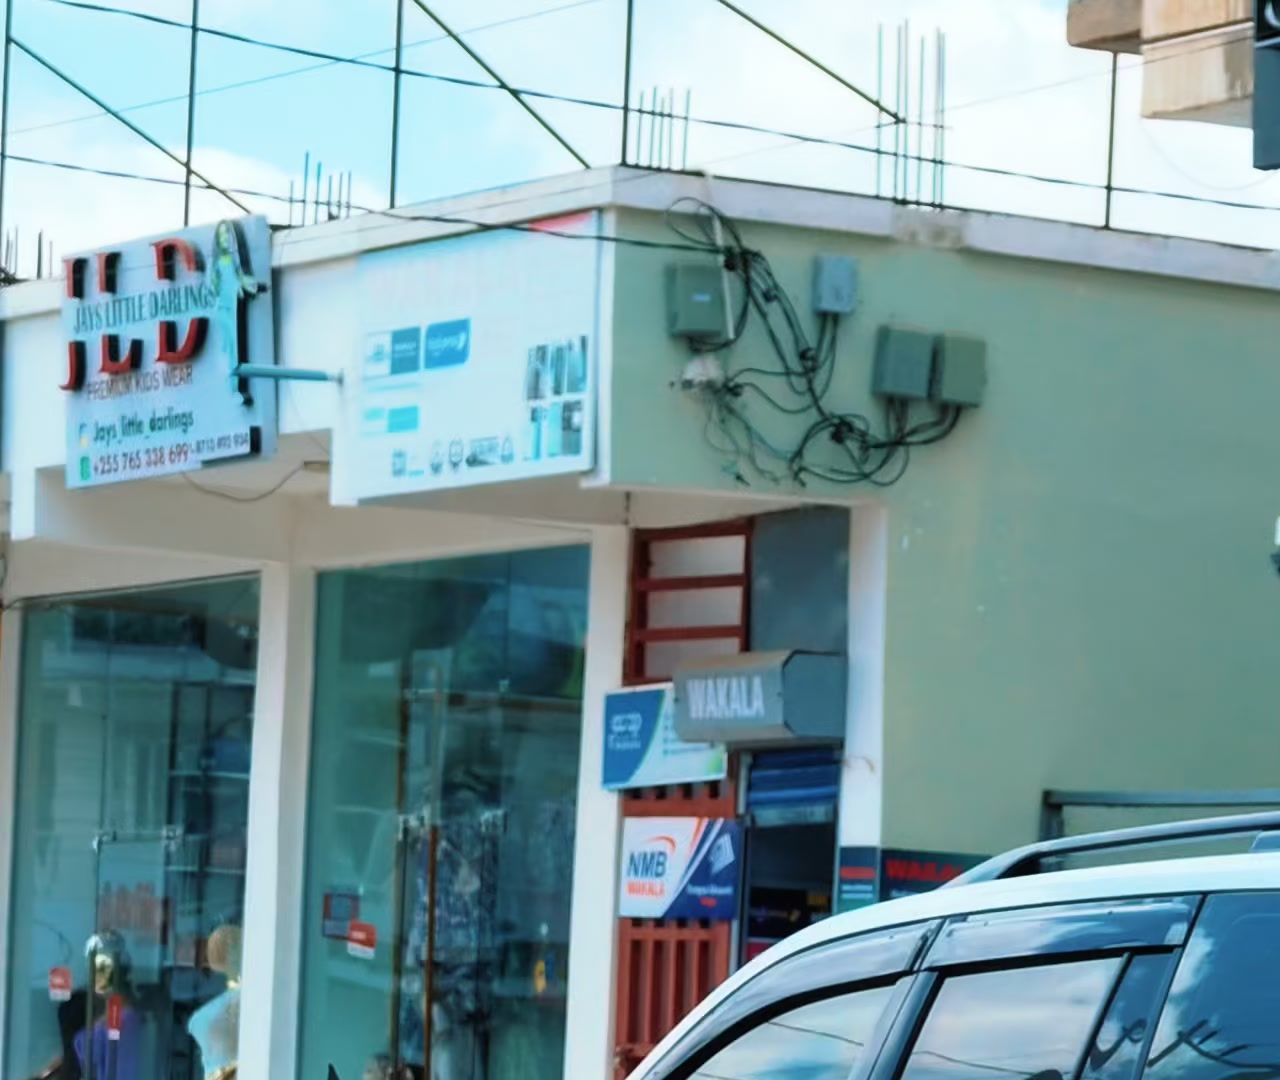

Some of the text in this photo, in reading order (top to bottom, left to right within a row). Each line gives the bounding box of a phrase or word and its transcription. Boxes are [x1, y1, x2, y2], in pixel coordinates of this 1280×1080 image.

[74, 282, 219, 334] JAYS LITTLE DARLINGS
[87, 366, 194, 400] PREMIUM KIDS WEAR
[93, 455, 119, 476] +255
[122, 451, 142, 472] 765
[168, 444, 189, 465] 699
[686, 675, 765, 720] WAKALA
[627, 850, 668, 878] NMB
